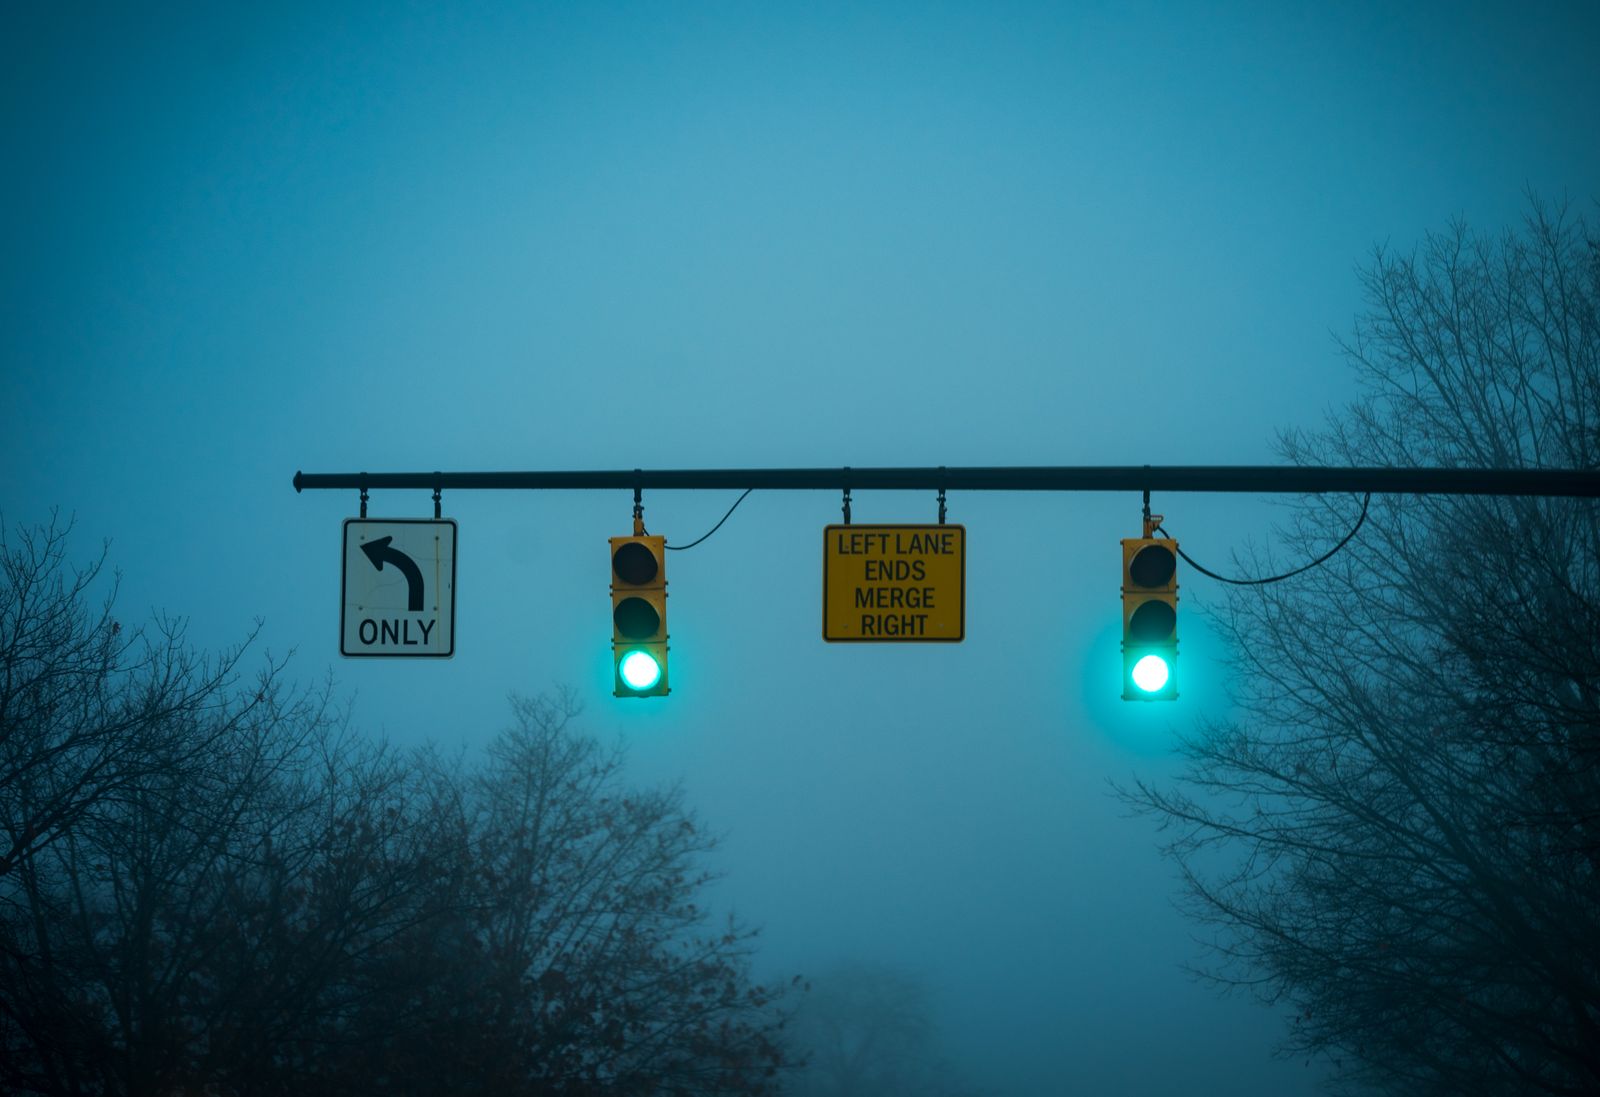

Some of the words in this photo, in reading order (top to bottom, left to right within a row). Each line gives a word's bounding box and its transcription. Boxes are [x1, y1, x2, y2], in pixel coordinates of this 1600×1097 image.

[838, 533, 891, 555] LEFT
[895, 533, 955, 555] LANE
[864, 559, 926, 582] ENDS
[854, 587, 936, 609] MERGE
[358, 618, 437, 645] ONLY
[861, 613, 929, 636] RIGHT
